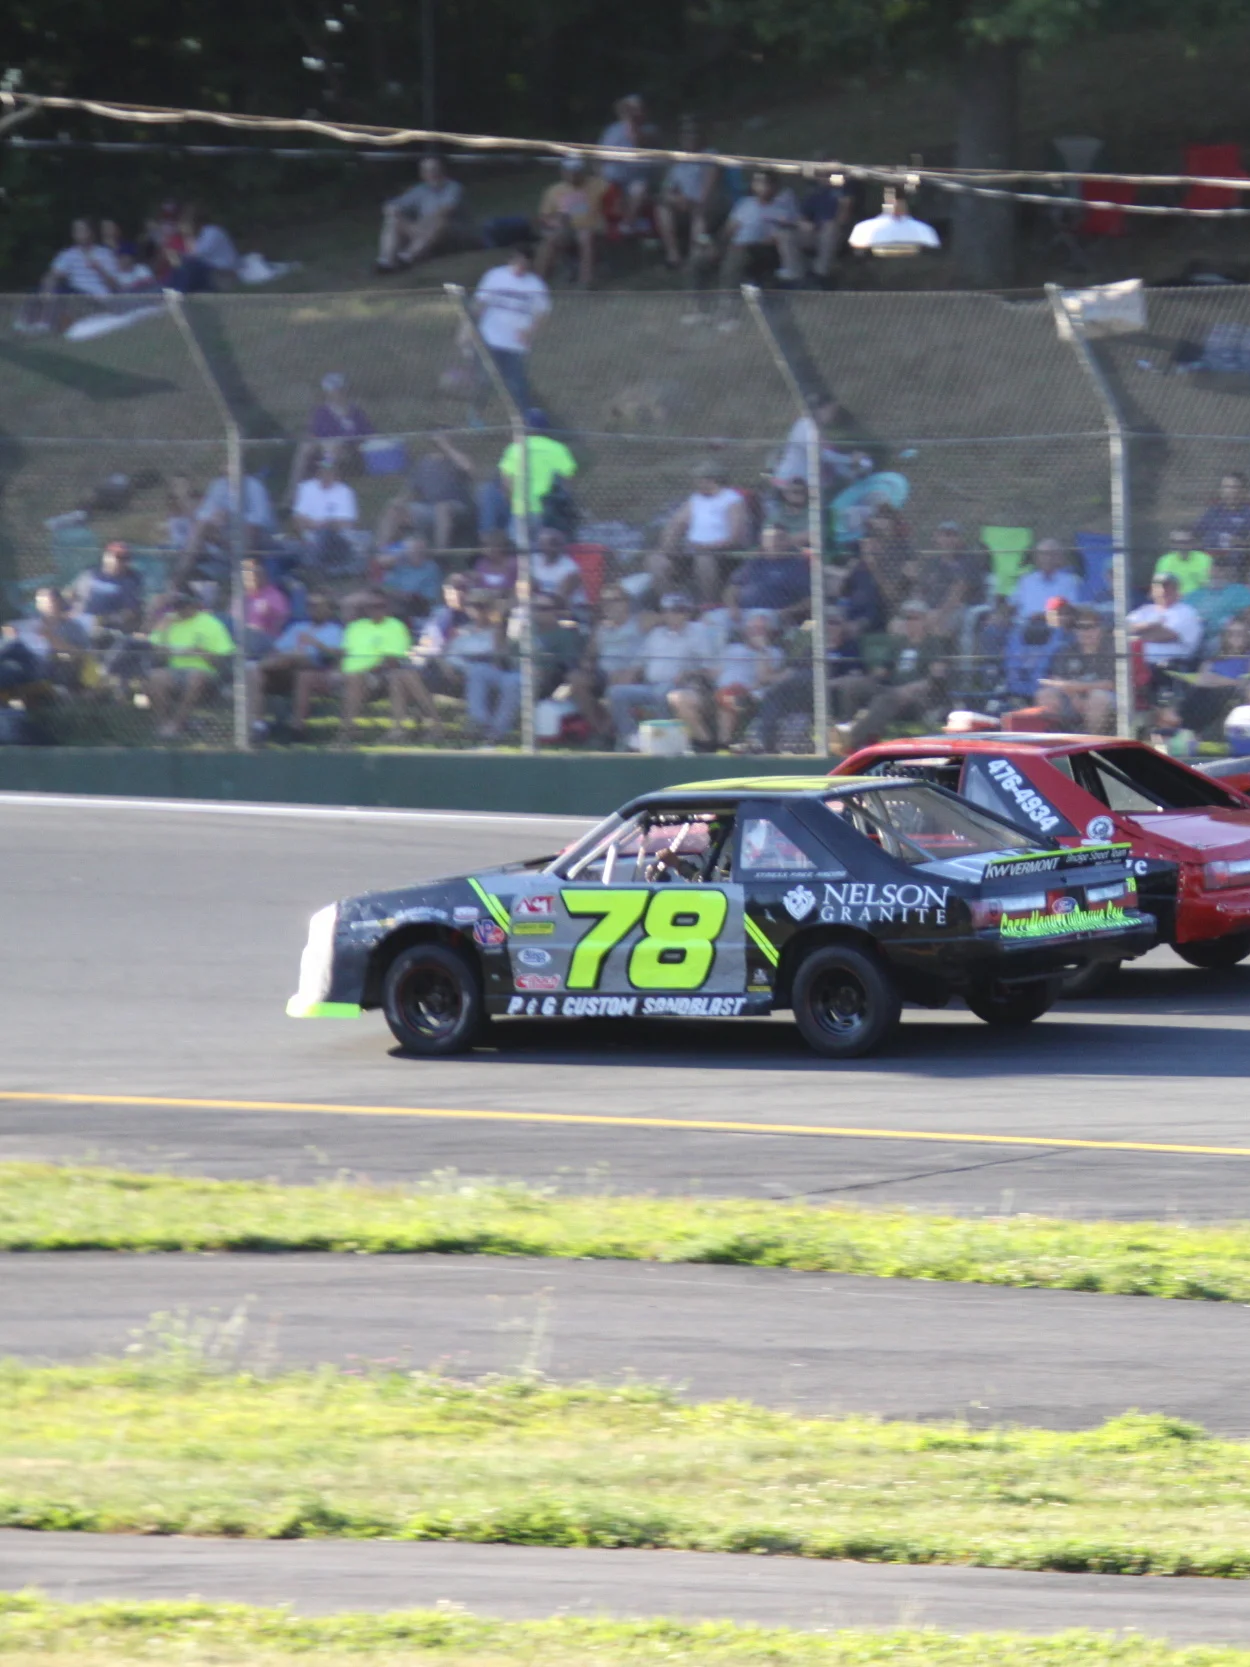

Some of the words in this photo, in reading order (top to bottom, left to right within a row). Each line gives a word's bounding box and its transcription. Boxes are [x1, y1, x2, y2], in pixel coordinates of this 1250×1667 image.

[987, 759, 1060, 832] 476-4934
[822, 883, 950, 908] NELSON
[820, 906, 947, 924] GRANITE
[560, 888, 729, 990] 78
[507, 996, 524, 1015] P
[541, 996, 556, 1016] G
[562, 996, 637, 1016] CUSTOM
[642, 996, 747, 1016] SANDBLAST
